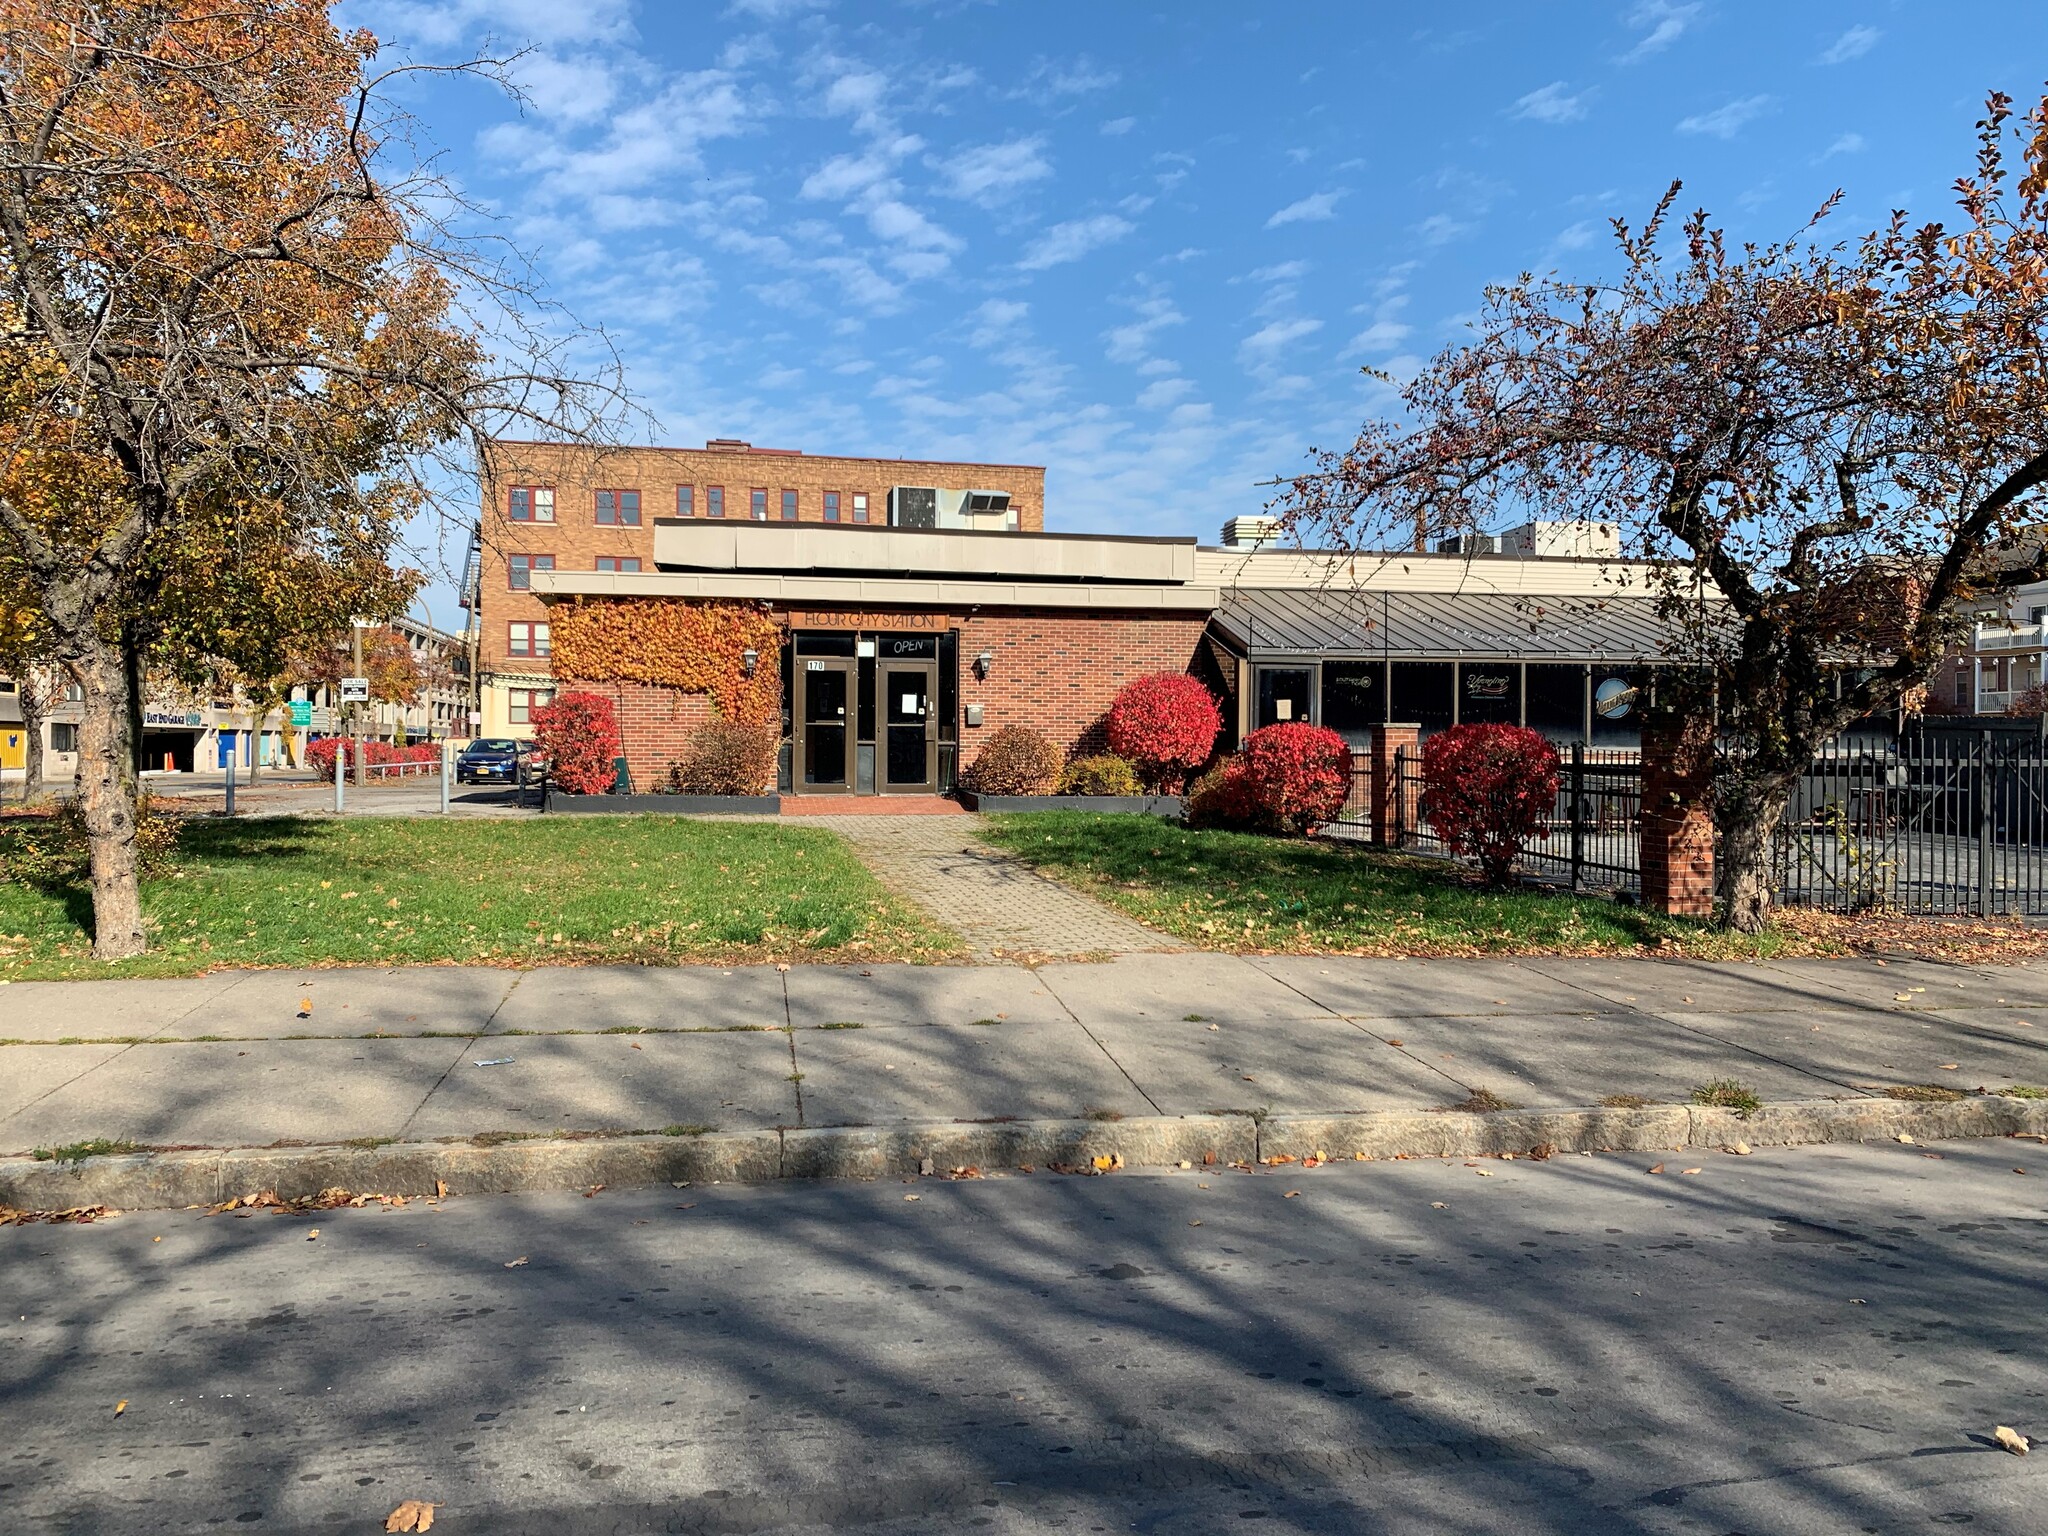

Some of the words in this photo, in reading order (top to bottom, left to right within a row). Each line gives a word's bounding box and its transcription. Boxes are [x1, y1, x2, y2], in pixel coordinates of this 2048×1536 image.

[805, 612, 846, 626] FLOUR
[882, 614, 934, 628] STATION
[893, 640, 924, 654] OPEN
[809, 661, 823, 670] 170
[146, 712, 158, 724] EAST
